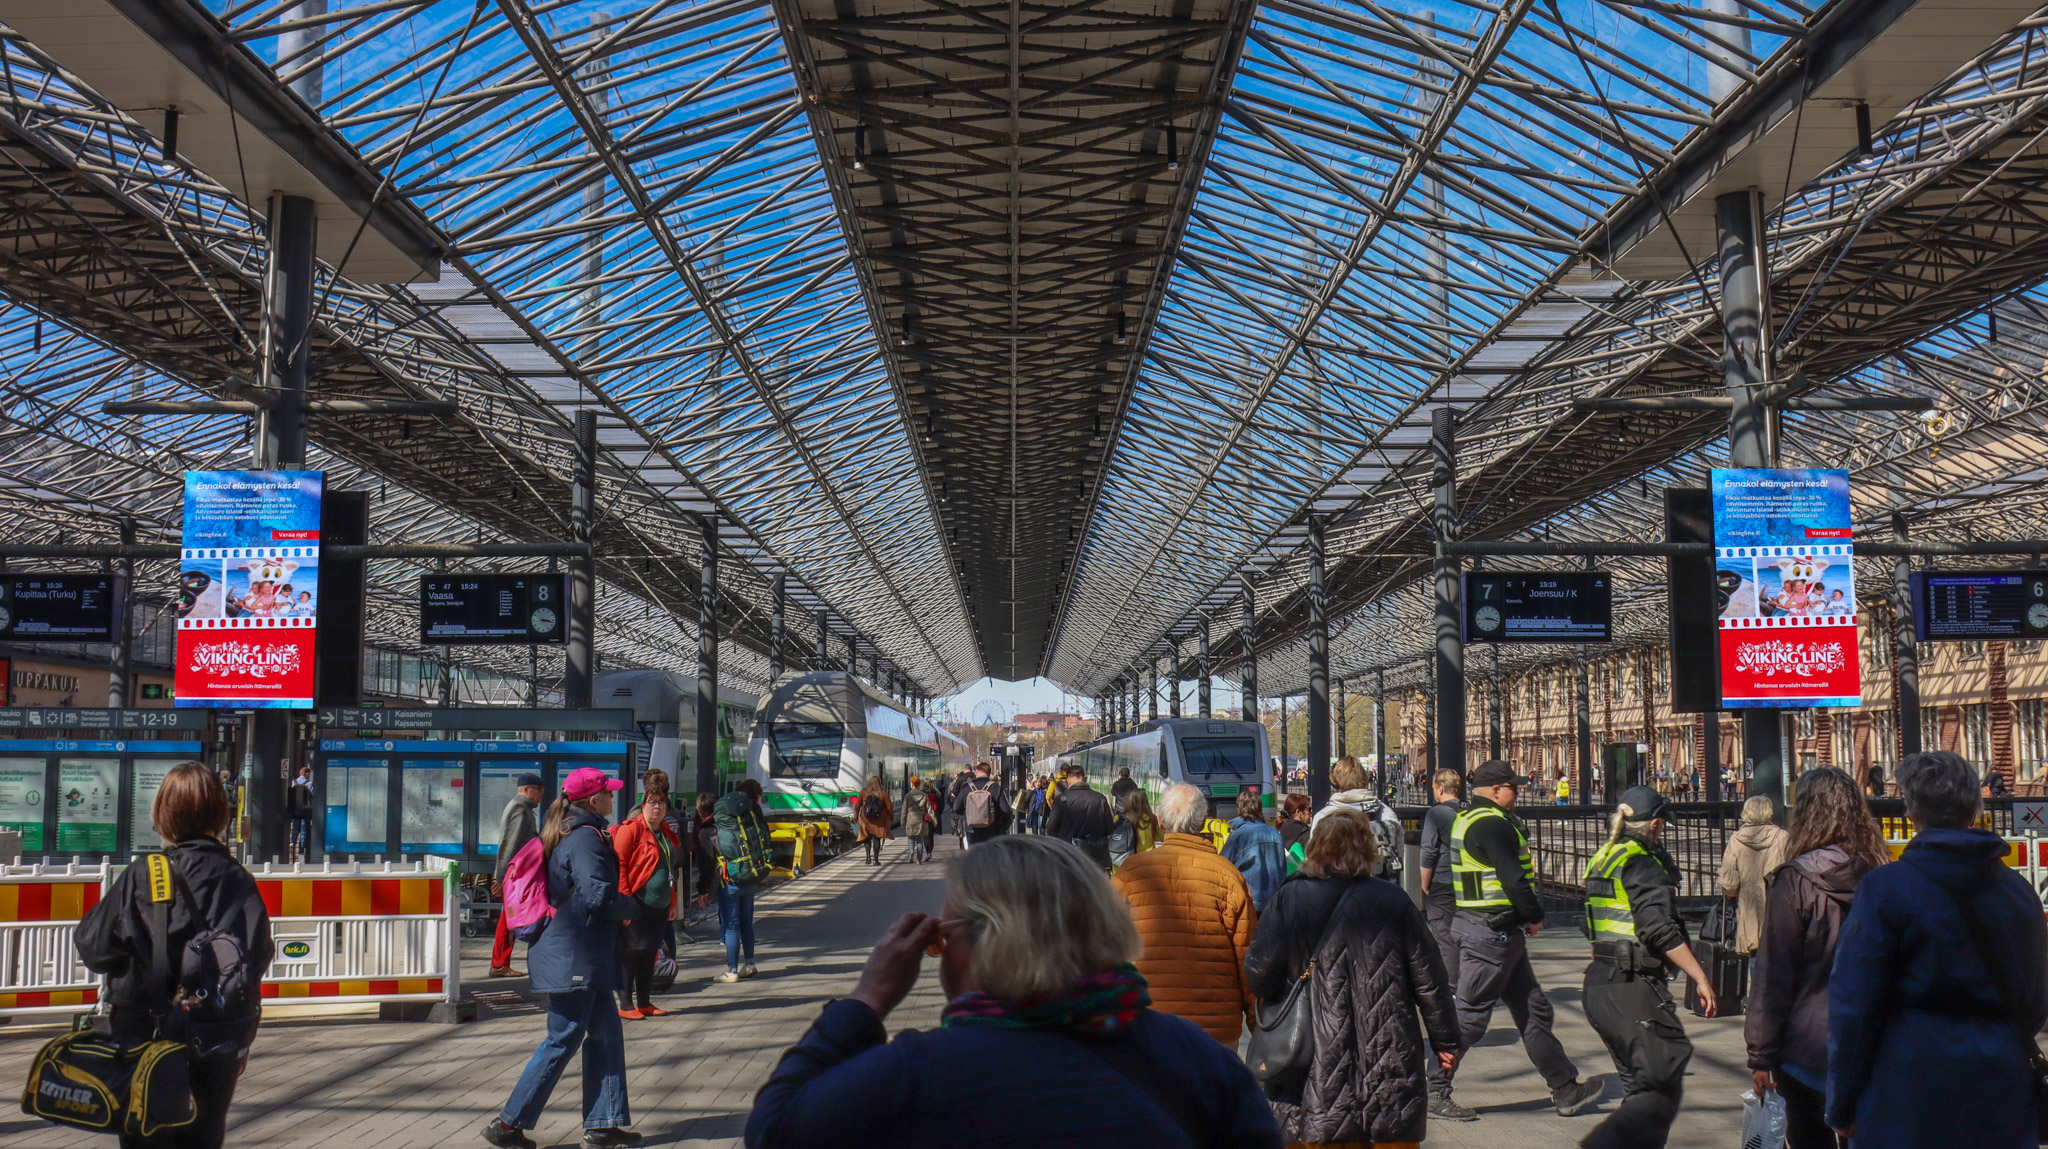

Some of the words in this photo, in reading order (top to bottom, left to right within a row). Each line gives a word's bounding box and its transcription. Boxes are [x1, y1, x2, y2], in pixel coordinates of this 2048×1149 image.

[197, 482, 231, 490] Ennakoi
[232, 481, 276, 491] elämysten
[277, 481, 301, 489] kesä!
[1724, 480, 1759, 488] Ennakoi
[1760, 480, 1805, 490] elämysten
[1805, 479, 1828, 488] kesä!
[15, 590, 47, 600] Kupittaa
[49, 590, 77, 600] (Turku)
[538, 585, 549, 601] 8
[1482, 584, 1493, 600] 7
[1529, 590, 1564, 598] Joensuu
[1571, 590, 1578, 598] K
[2033, 582, 2044, 597] 6
[428, 592, 454, 600] Vaasa
[198, 652, 254, 665] VIKING
[257, 652, 292, 665] LINE
[1743, 651, 1799, 664] VIKING
[1801, 651, 1837, 664] LINE
[142, 713, 177, 726] 12-19
[362, 712, 382, 724] 1-3
[395, 710, 432, 718] Kaisaniemi
[395, 720, 432, 728] Kajsaniemi
[152, 855, 164, 899] KETTLER
[285, 946, 308, 954] hrk.fi
[39, 1080, 93, 1104] KETTLER
[54, 1100, 99, 1114] SPORT
